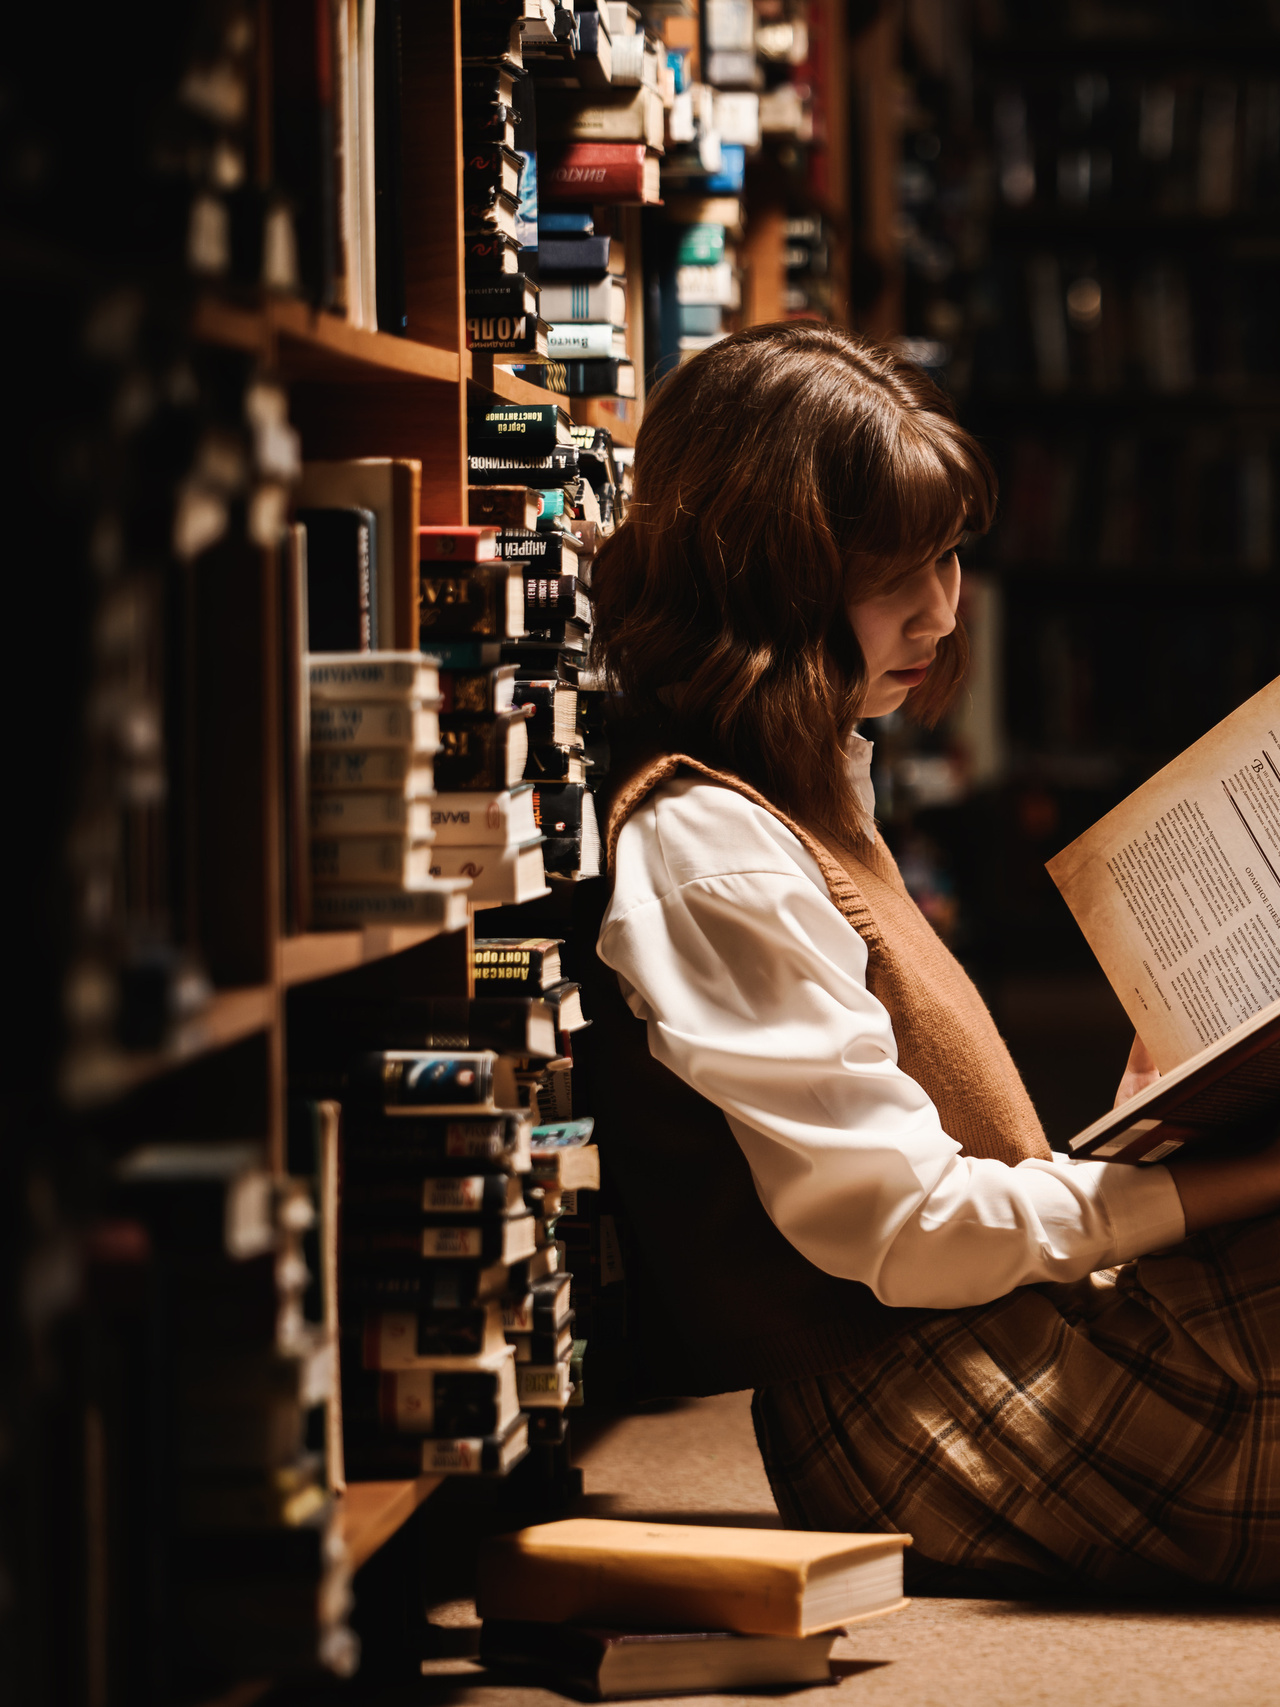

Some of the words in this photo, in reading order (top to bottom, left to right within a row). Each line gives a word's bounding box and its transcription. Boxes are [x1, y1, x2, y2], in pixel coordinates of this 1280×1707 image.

[485, 412, 542, 422] Константинов
[498, 422, 526, 434] Сергей
[556, 456, 567, 469] А.
[504, 541, 547, 558] АНДРЕЙ
[1245, 866, 1269, 904] ОРЛИНОЕ
